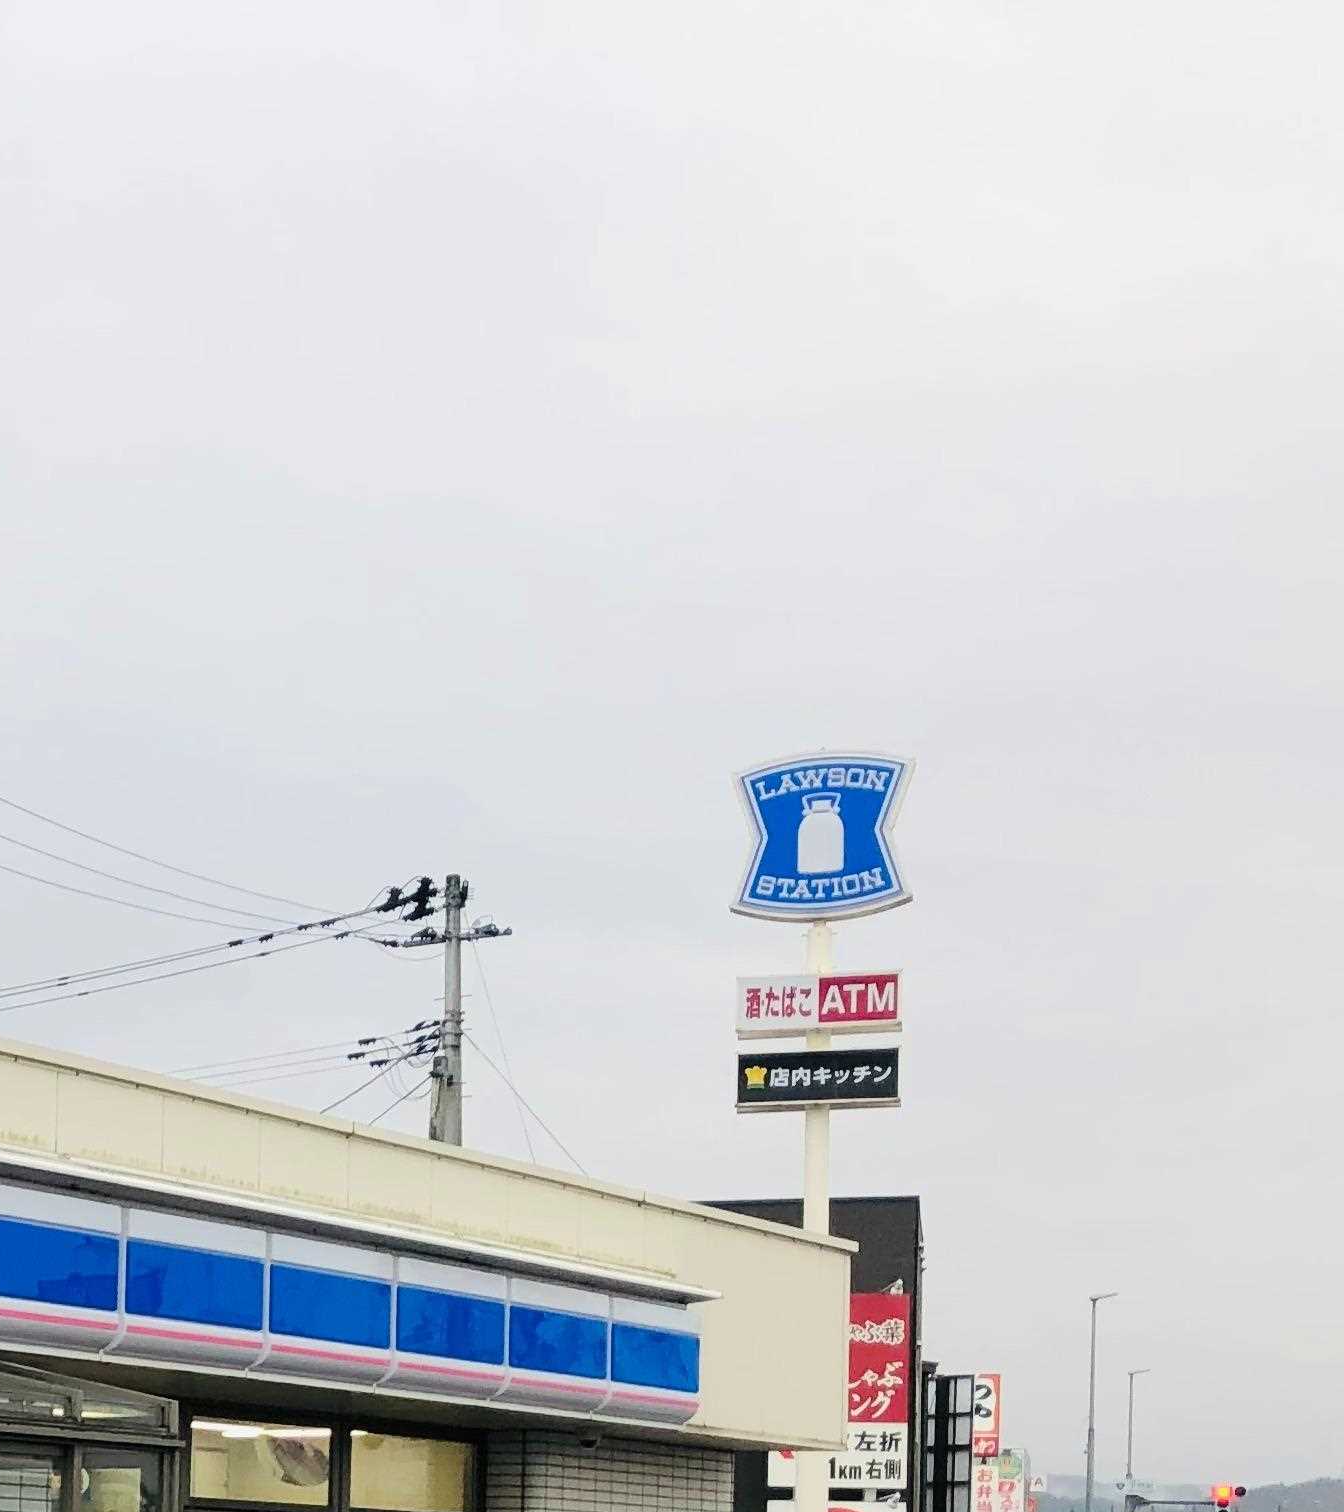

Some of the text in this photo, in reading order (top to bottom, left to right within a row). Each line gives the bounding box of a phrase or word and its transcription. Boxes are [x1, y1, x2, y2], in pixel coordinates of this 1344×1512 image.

[756, 767, 889, 801] LAWSON
[756, 867, 885, 899] STATION
[821, 982, 895, 1015] ATM
[769, 1065, 892, 1087] 店内キッチン
[854, 1431, 901, 1453] 左折
[866, 1459, 901, 1480] 右側
